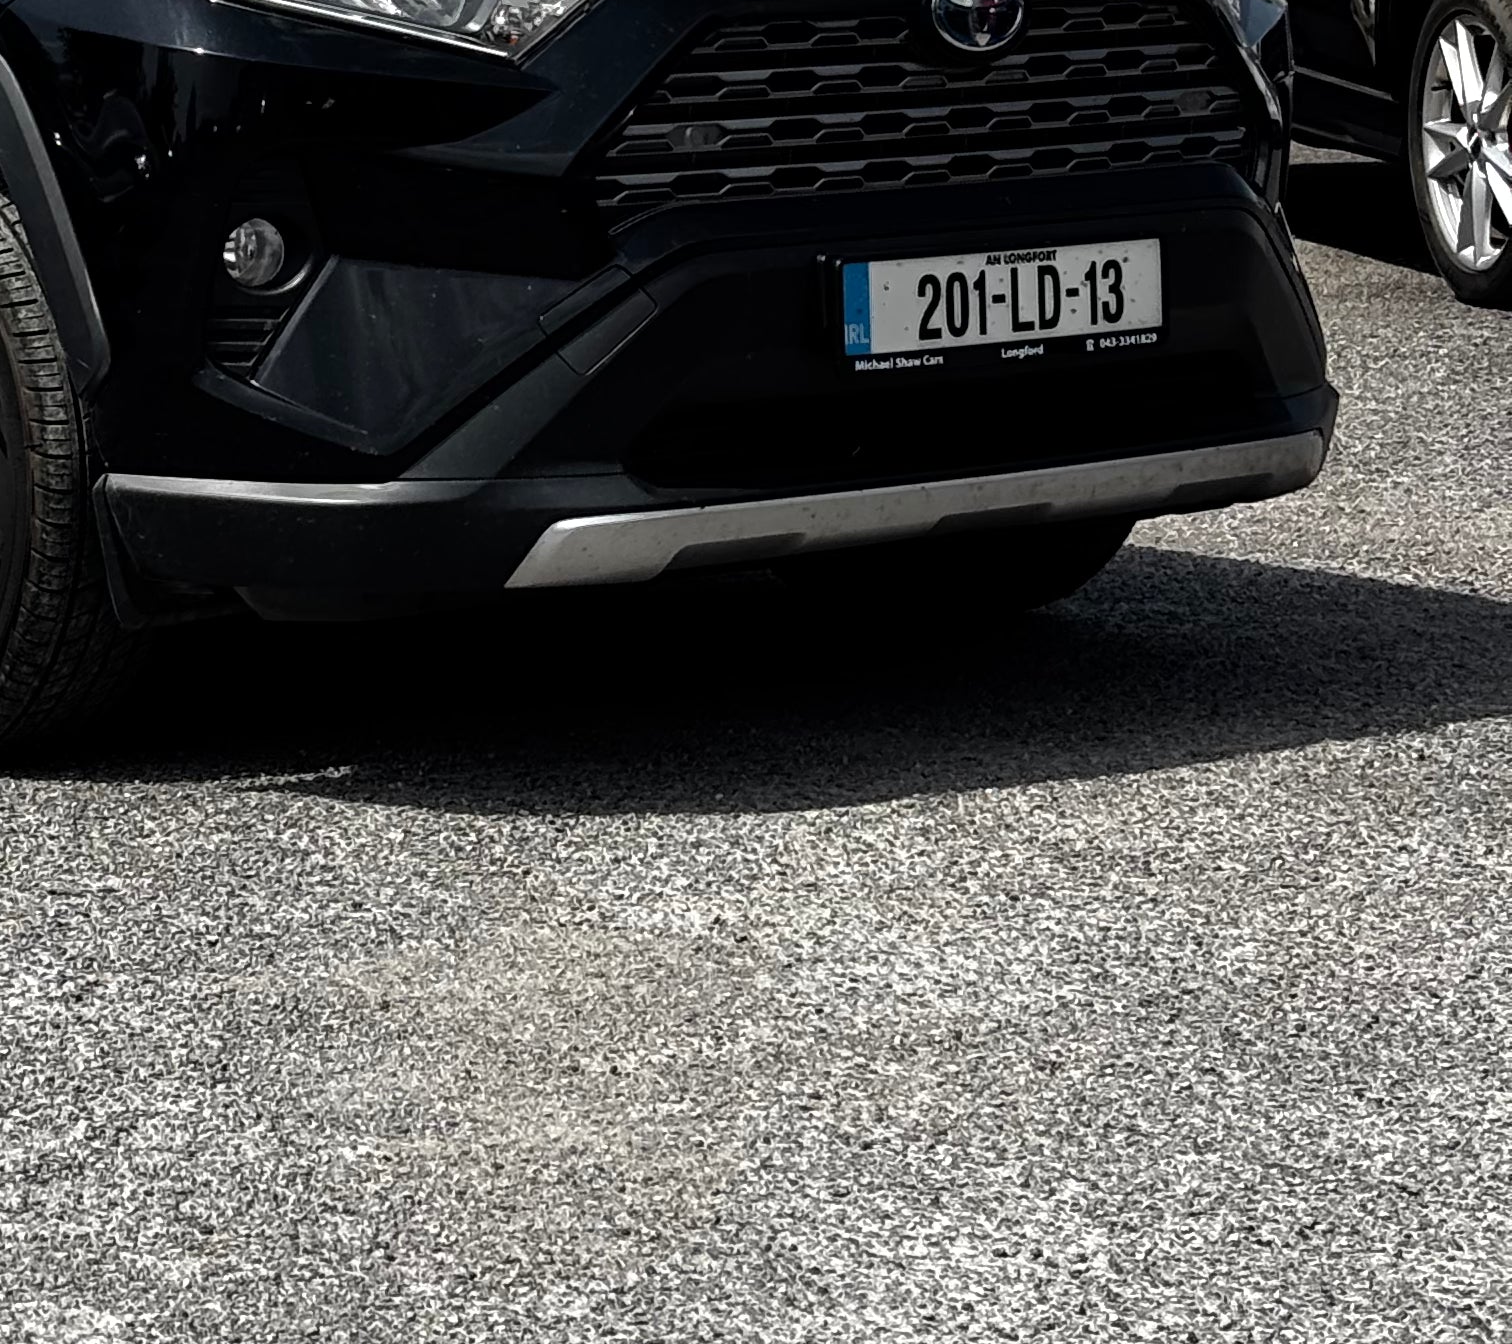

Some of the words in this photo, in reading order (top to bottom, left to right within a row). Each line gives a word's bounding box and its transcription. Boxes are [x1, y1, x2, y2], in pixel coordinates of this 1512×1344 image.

[916, 258, 1125, 342] 201-LD-13
[844, 322, 870, 345] IRL
[1001, 343, 1045, 360] Longford
[855, 356, 894, 372] Michael
[895, 356, 921, 368] Shaw
[922, 354, 944, 366] Cars
